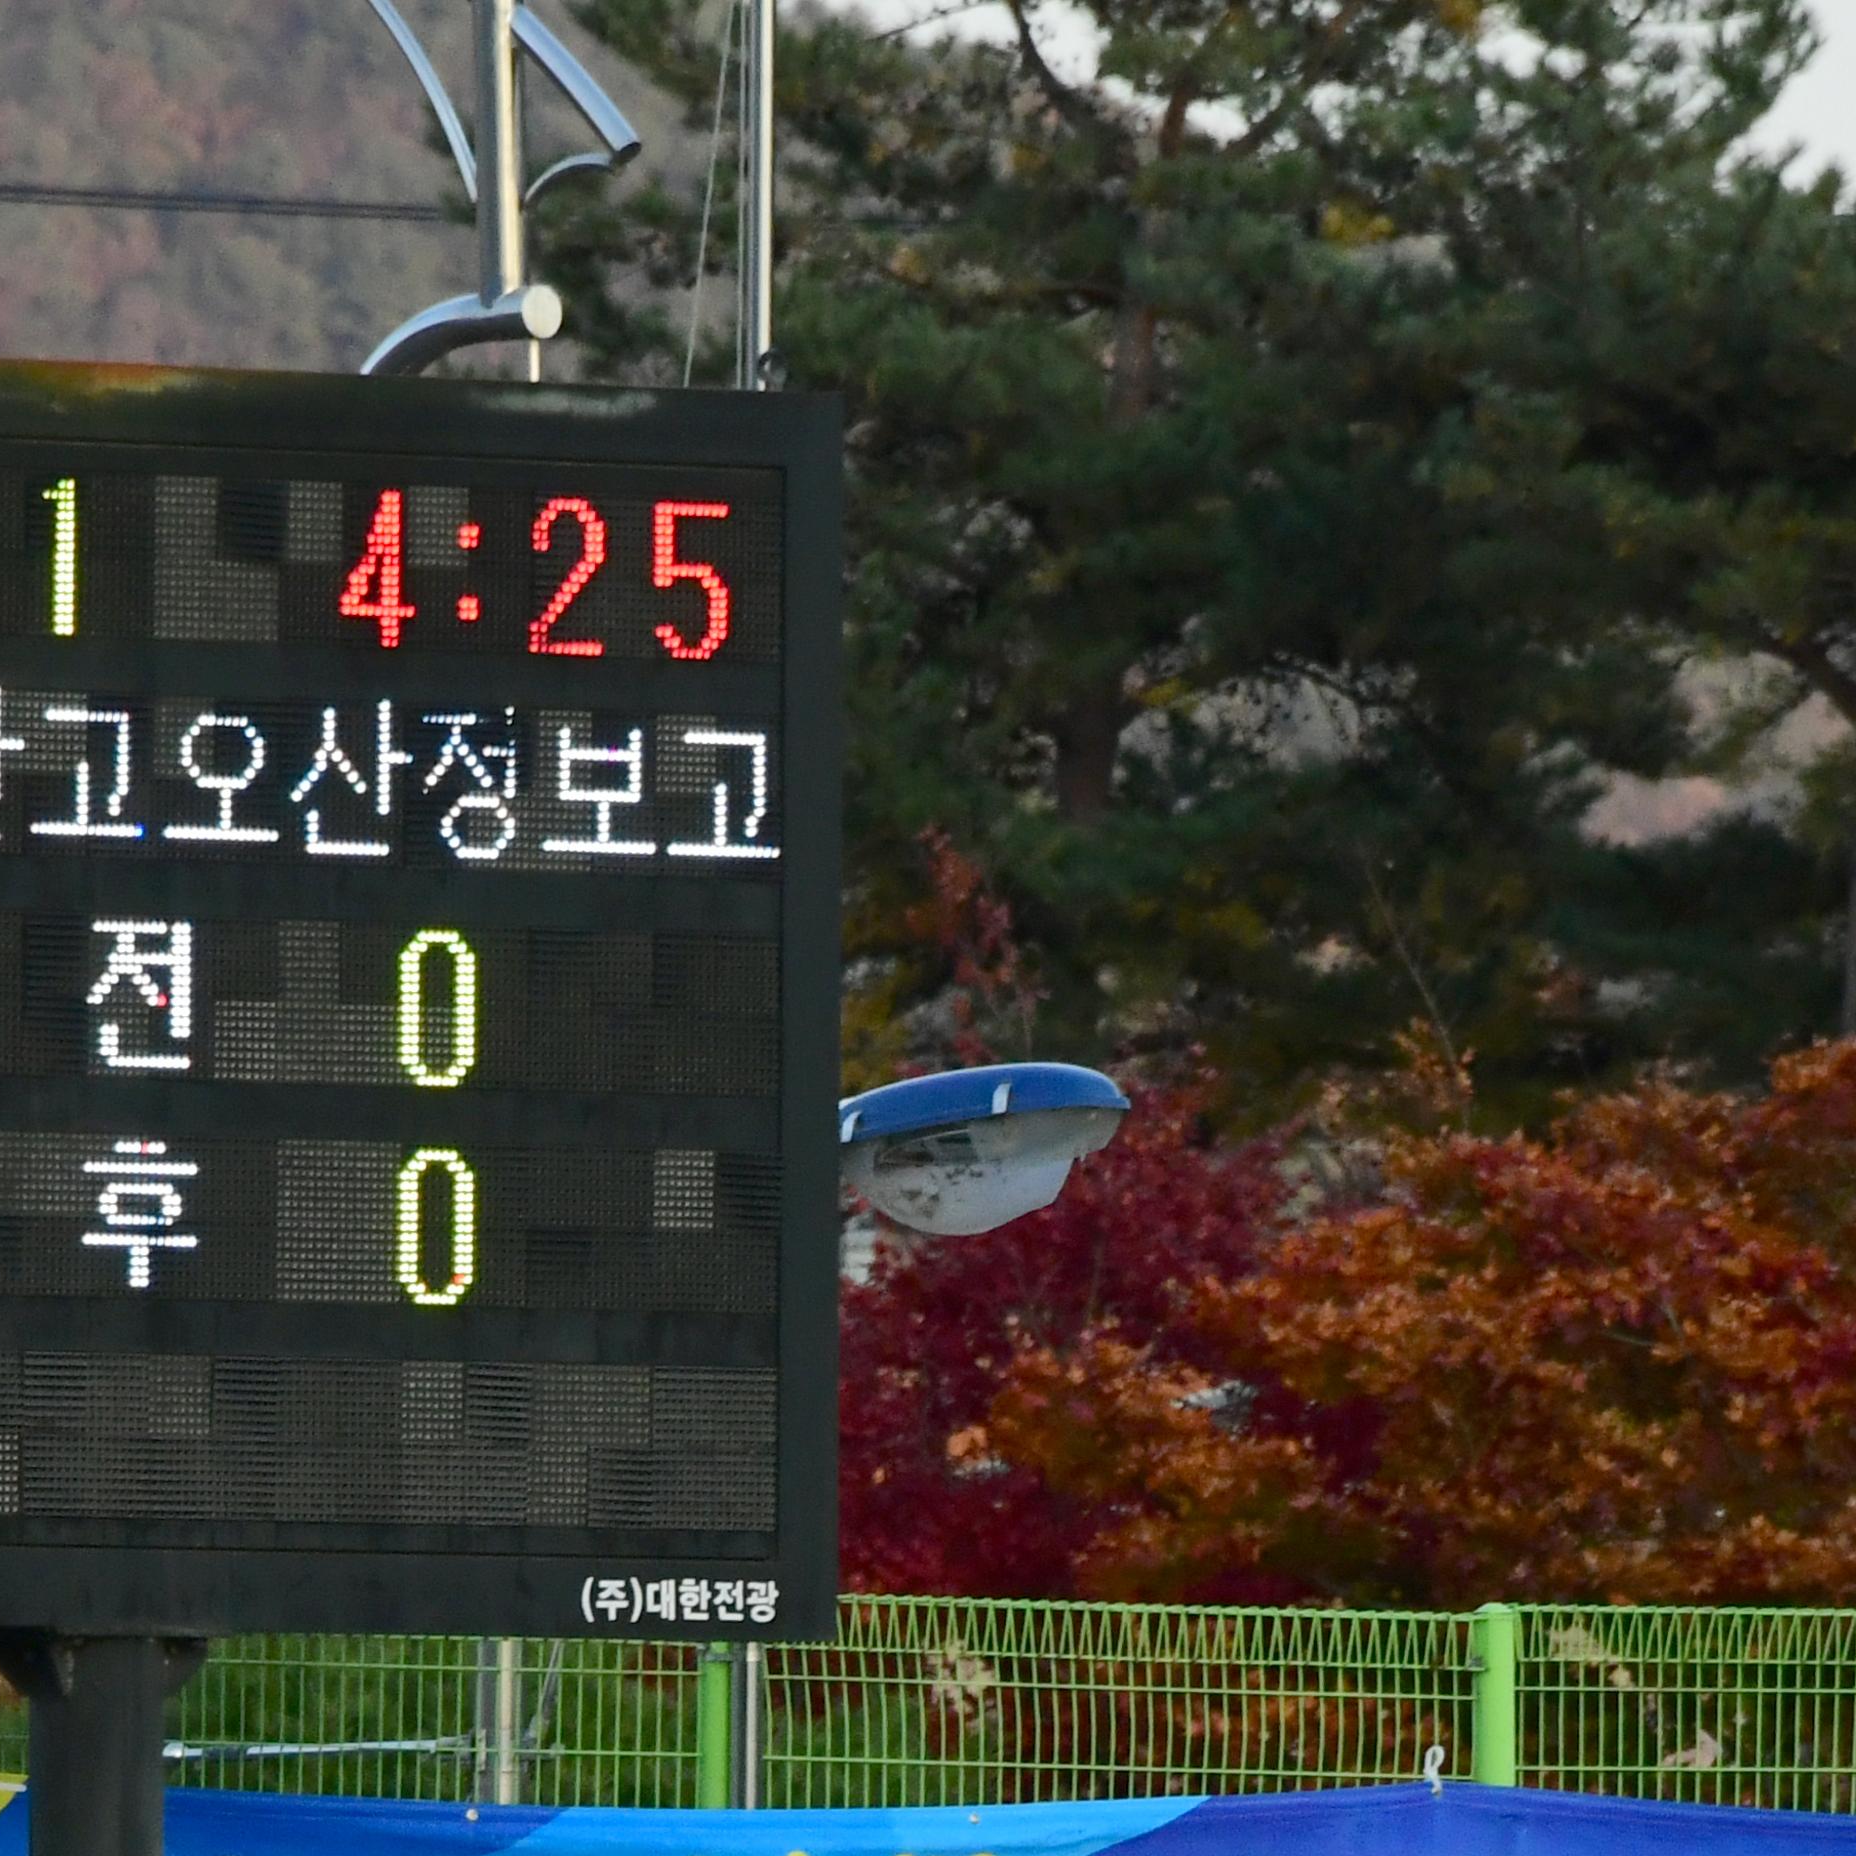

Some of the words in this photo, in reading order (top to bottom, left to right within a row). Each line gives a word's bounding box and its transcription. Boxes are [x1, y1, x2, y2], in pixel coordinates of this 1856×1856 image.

[340, 488, 731, 661] 4:25
[84, 919, 194, 1071] 전
[395, 928, 479, 1088] 0
[80, 1139, 200, 1290] 후
[394, 1147, 478, 1307] 0
[580, 1575, 781, 1624] (주)대한전광
